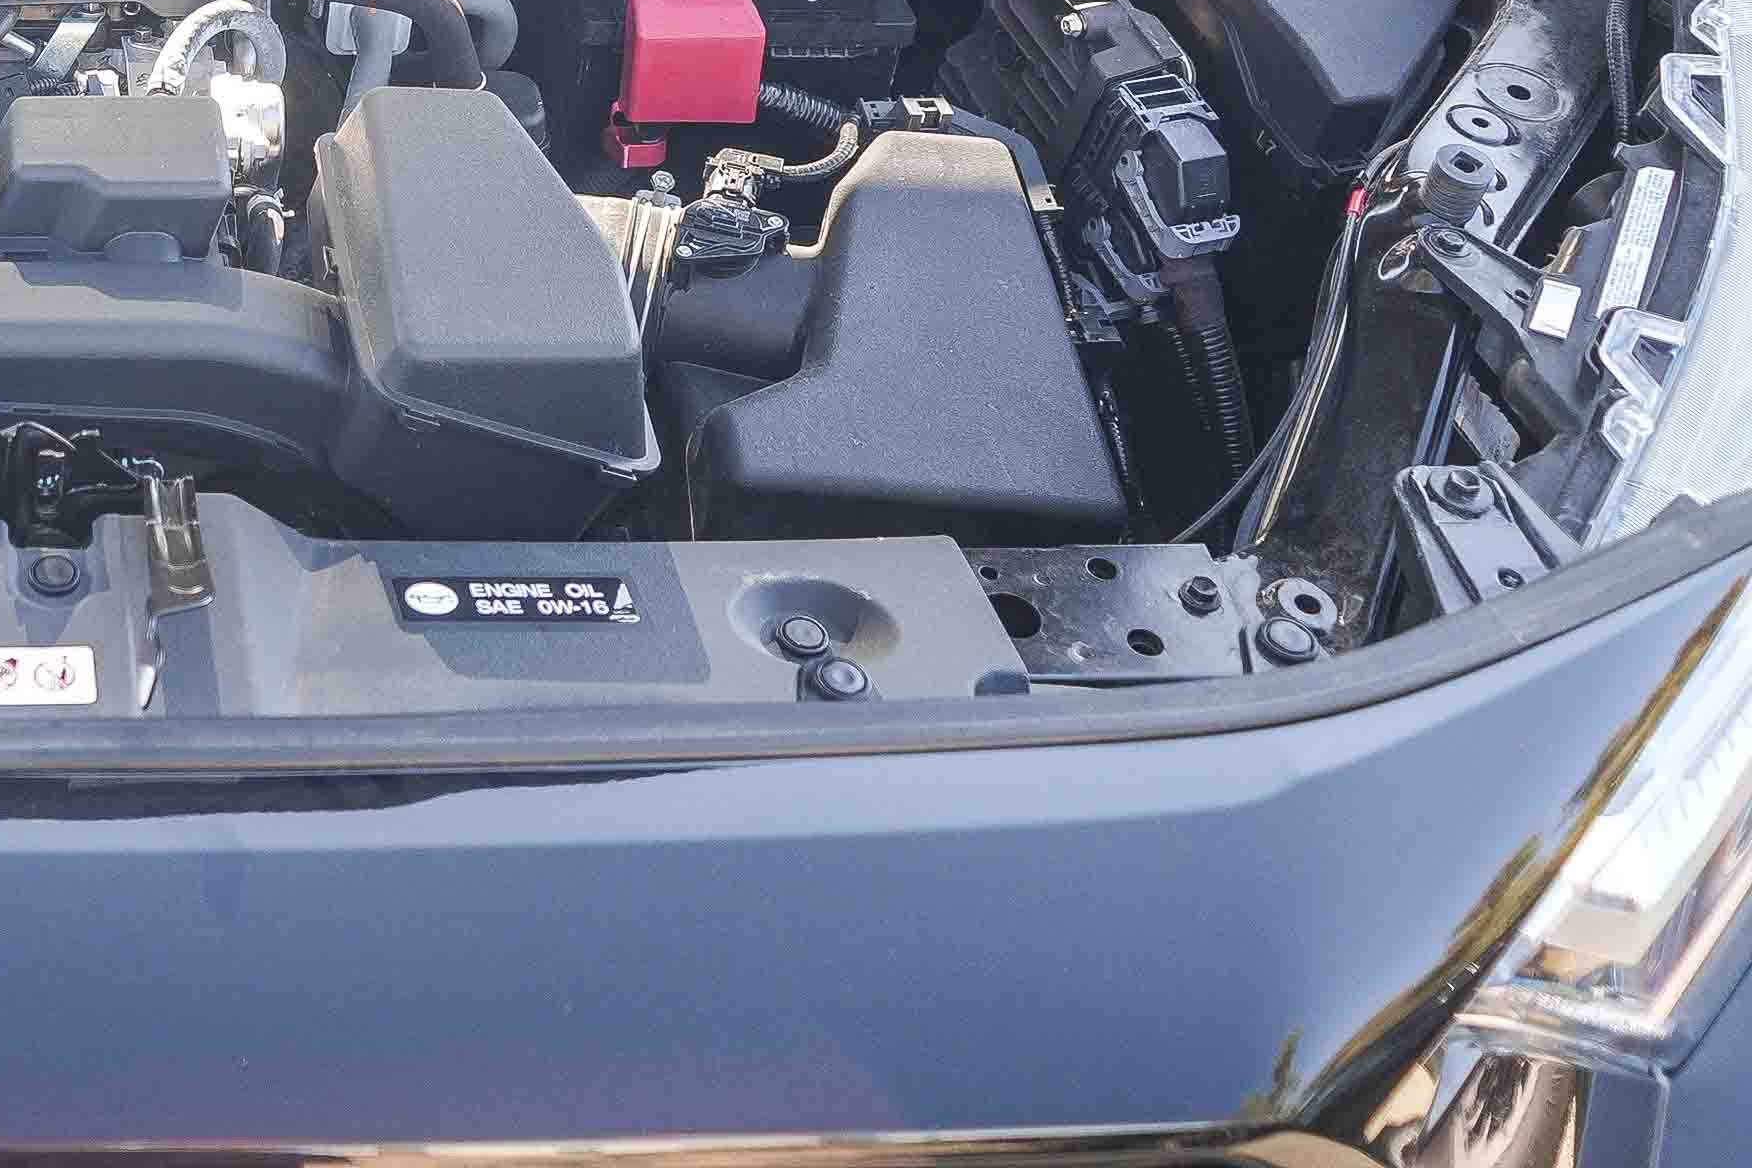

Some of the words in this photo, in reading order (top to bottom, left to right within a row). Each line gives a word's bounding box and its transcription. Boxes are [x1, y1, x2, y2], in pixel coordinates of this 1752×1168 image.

[468, 582, 553, 598] ENGINE
[564, 582, 605, 598] OIL
[475, 599, 524, 614] SAE
[536, 599, 609, 615] 0W-16
